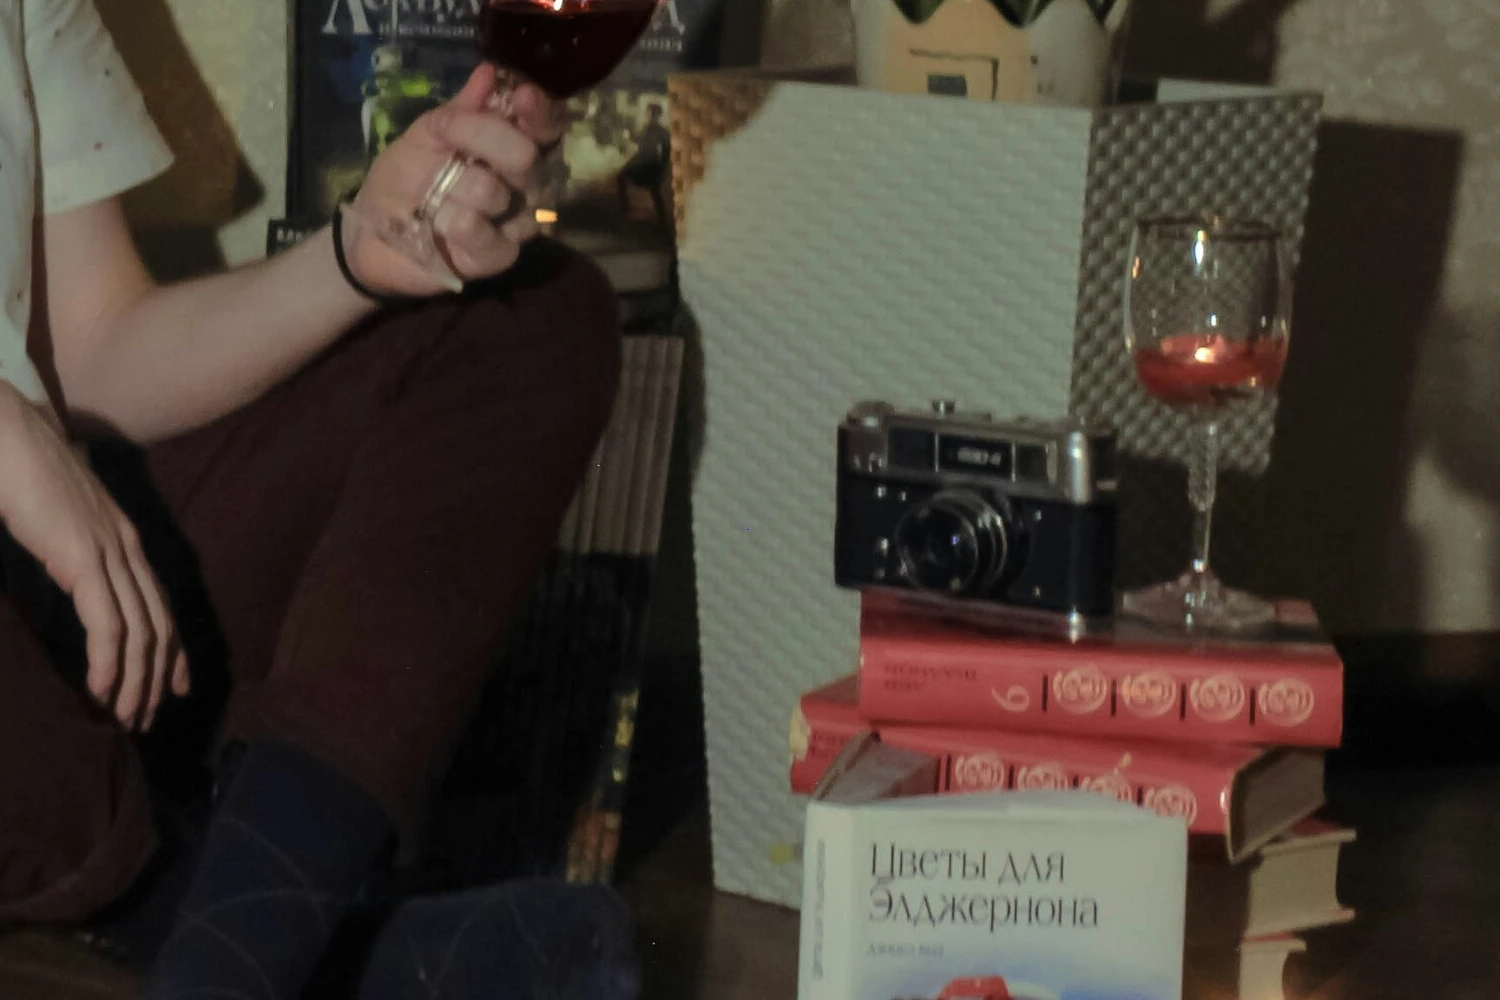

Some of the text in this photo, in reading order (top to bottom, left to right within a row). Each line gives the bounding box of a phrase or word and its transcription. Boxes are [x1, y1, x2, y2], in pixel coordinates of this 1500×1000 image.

[870, 840, 1066, 887] Цветы для
[869, 881, 1098, 935] Элджернона
